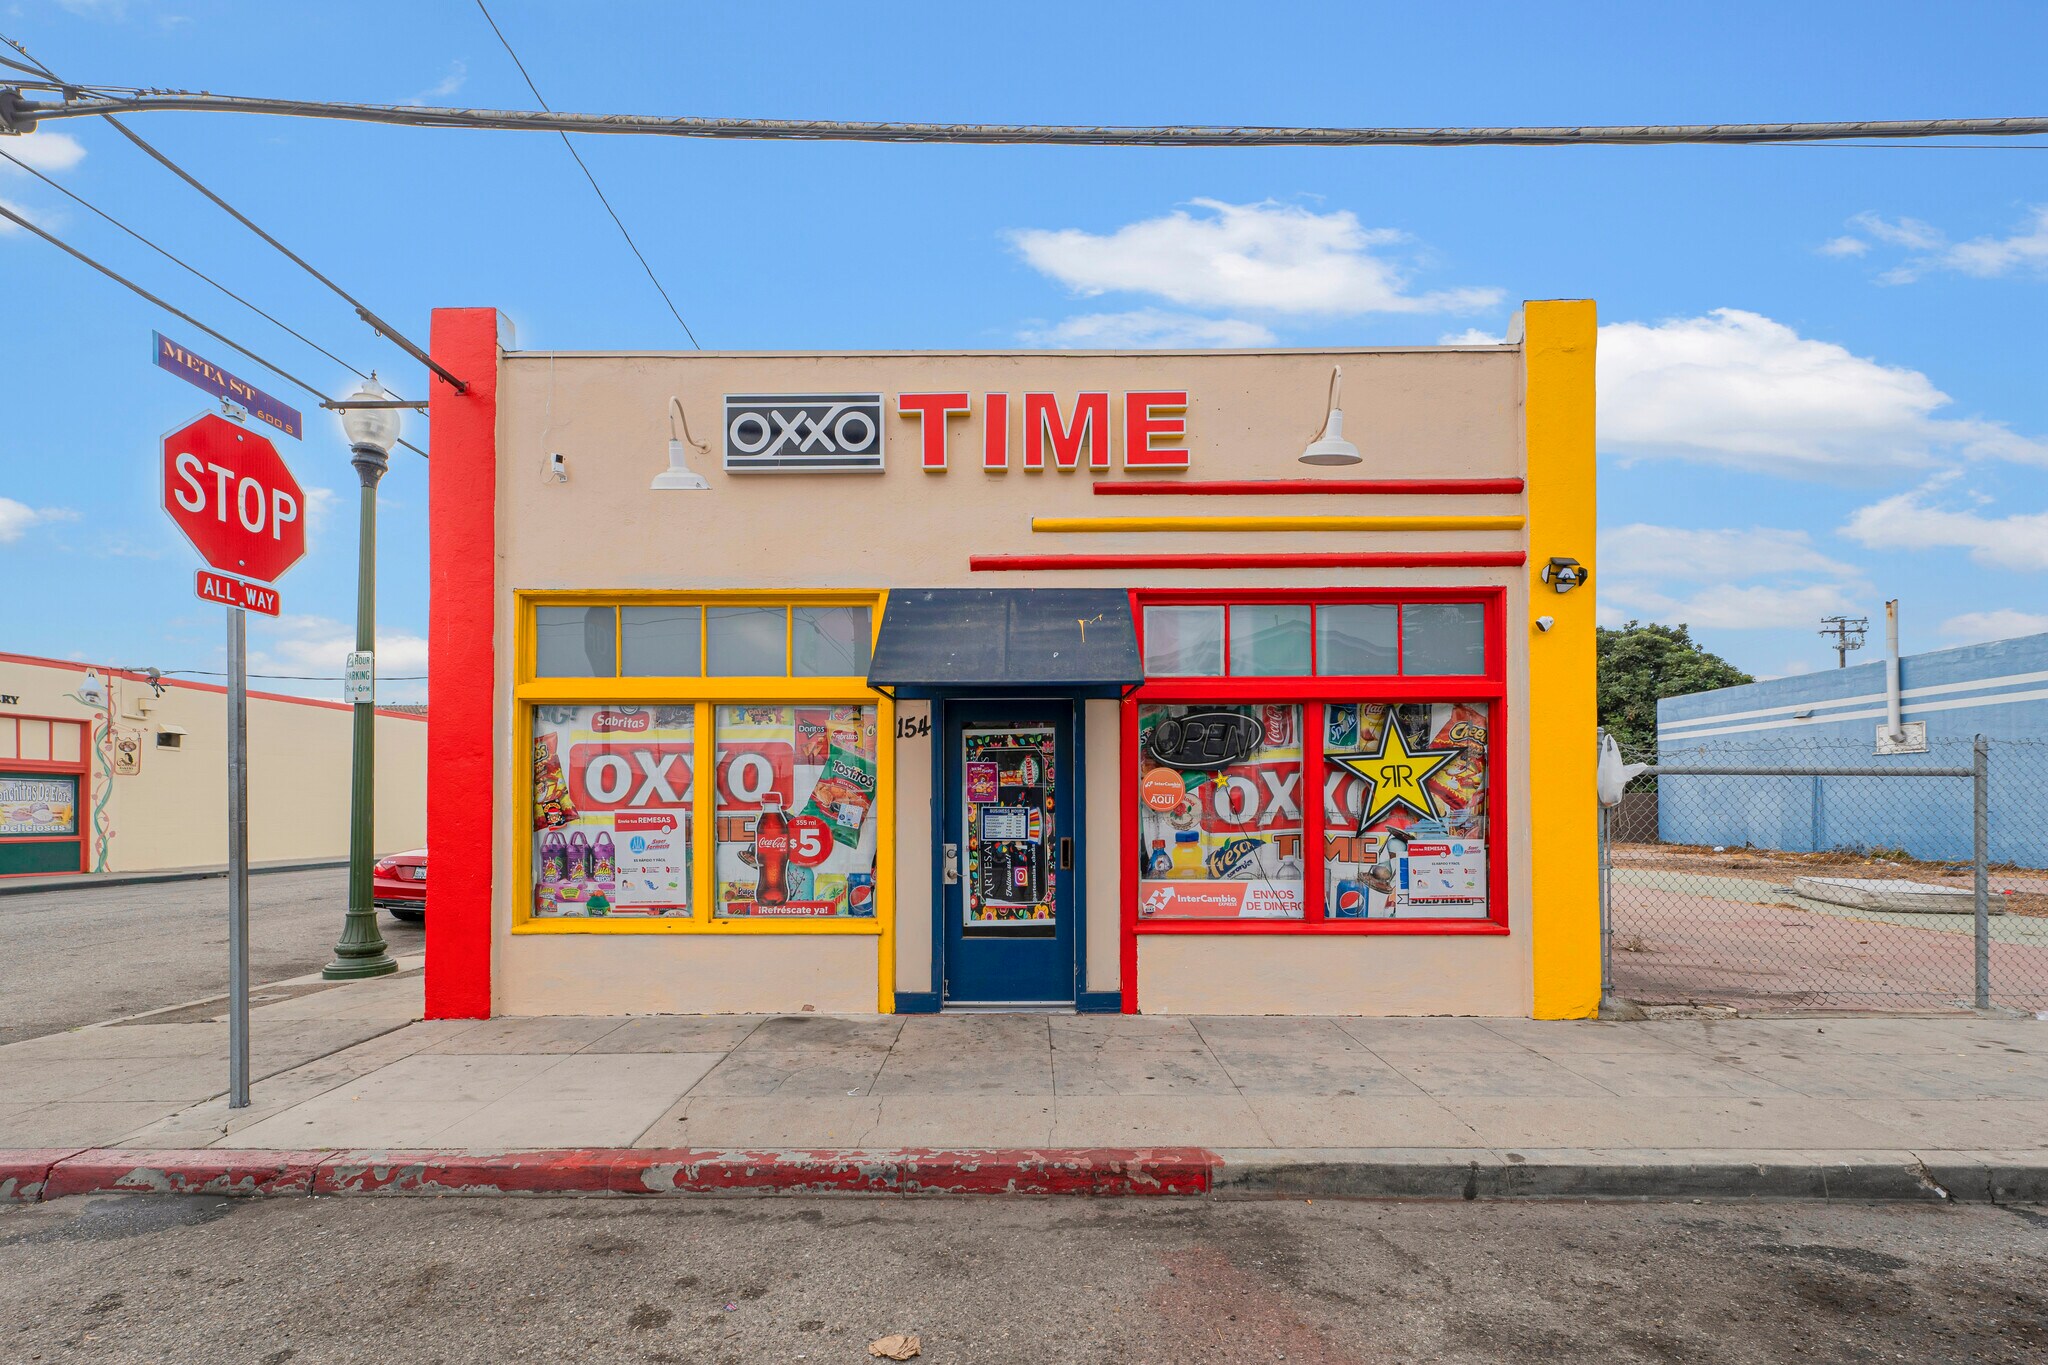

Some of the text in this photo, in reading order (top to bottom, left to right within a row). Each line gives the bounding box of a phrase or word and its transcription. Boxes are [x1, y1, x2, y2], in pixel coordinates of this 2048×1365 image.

[163, 340, 256, 401] META ST
[257, 410, 294, 434] 600 S
[729, 391, 1190, 472] OXXO TIME
[174, 452, 298, 541] STOP
[203, 577, 274, 610] ALL WAY
[355, 656, 370, 665] HOUR
[346, 670, 370, 681] PARKING
[597, 714, 645, 729] Sabritas
[896, 715, 931, 738] 154
[798, 725, 825, 733] Doritos
[1155, 720, 1252, 759] OPEN
[638, 816, 671, 824] REMESAS
[0, 824, 66, 833] Deliciosas
[1177, 894, 1237, 904] InterCambio
[1253, 890, 1295, 899] ENVIOS
[758, 905, 828, 916] ¡Refréscate ya!
[1246, 902, 1262, 911] DE
